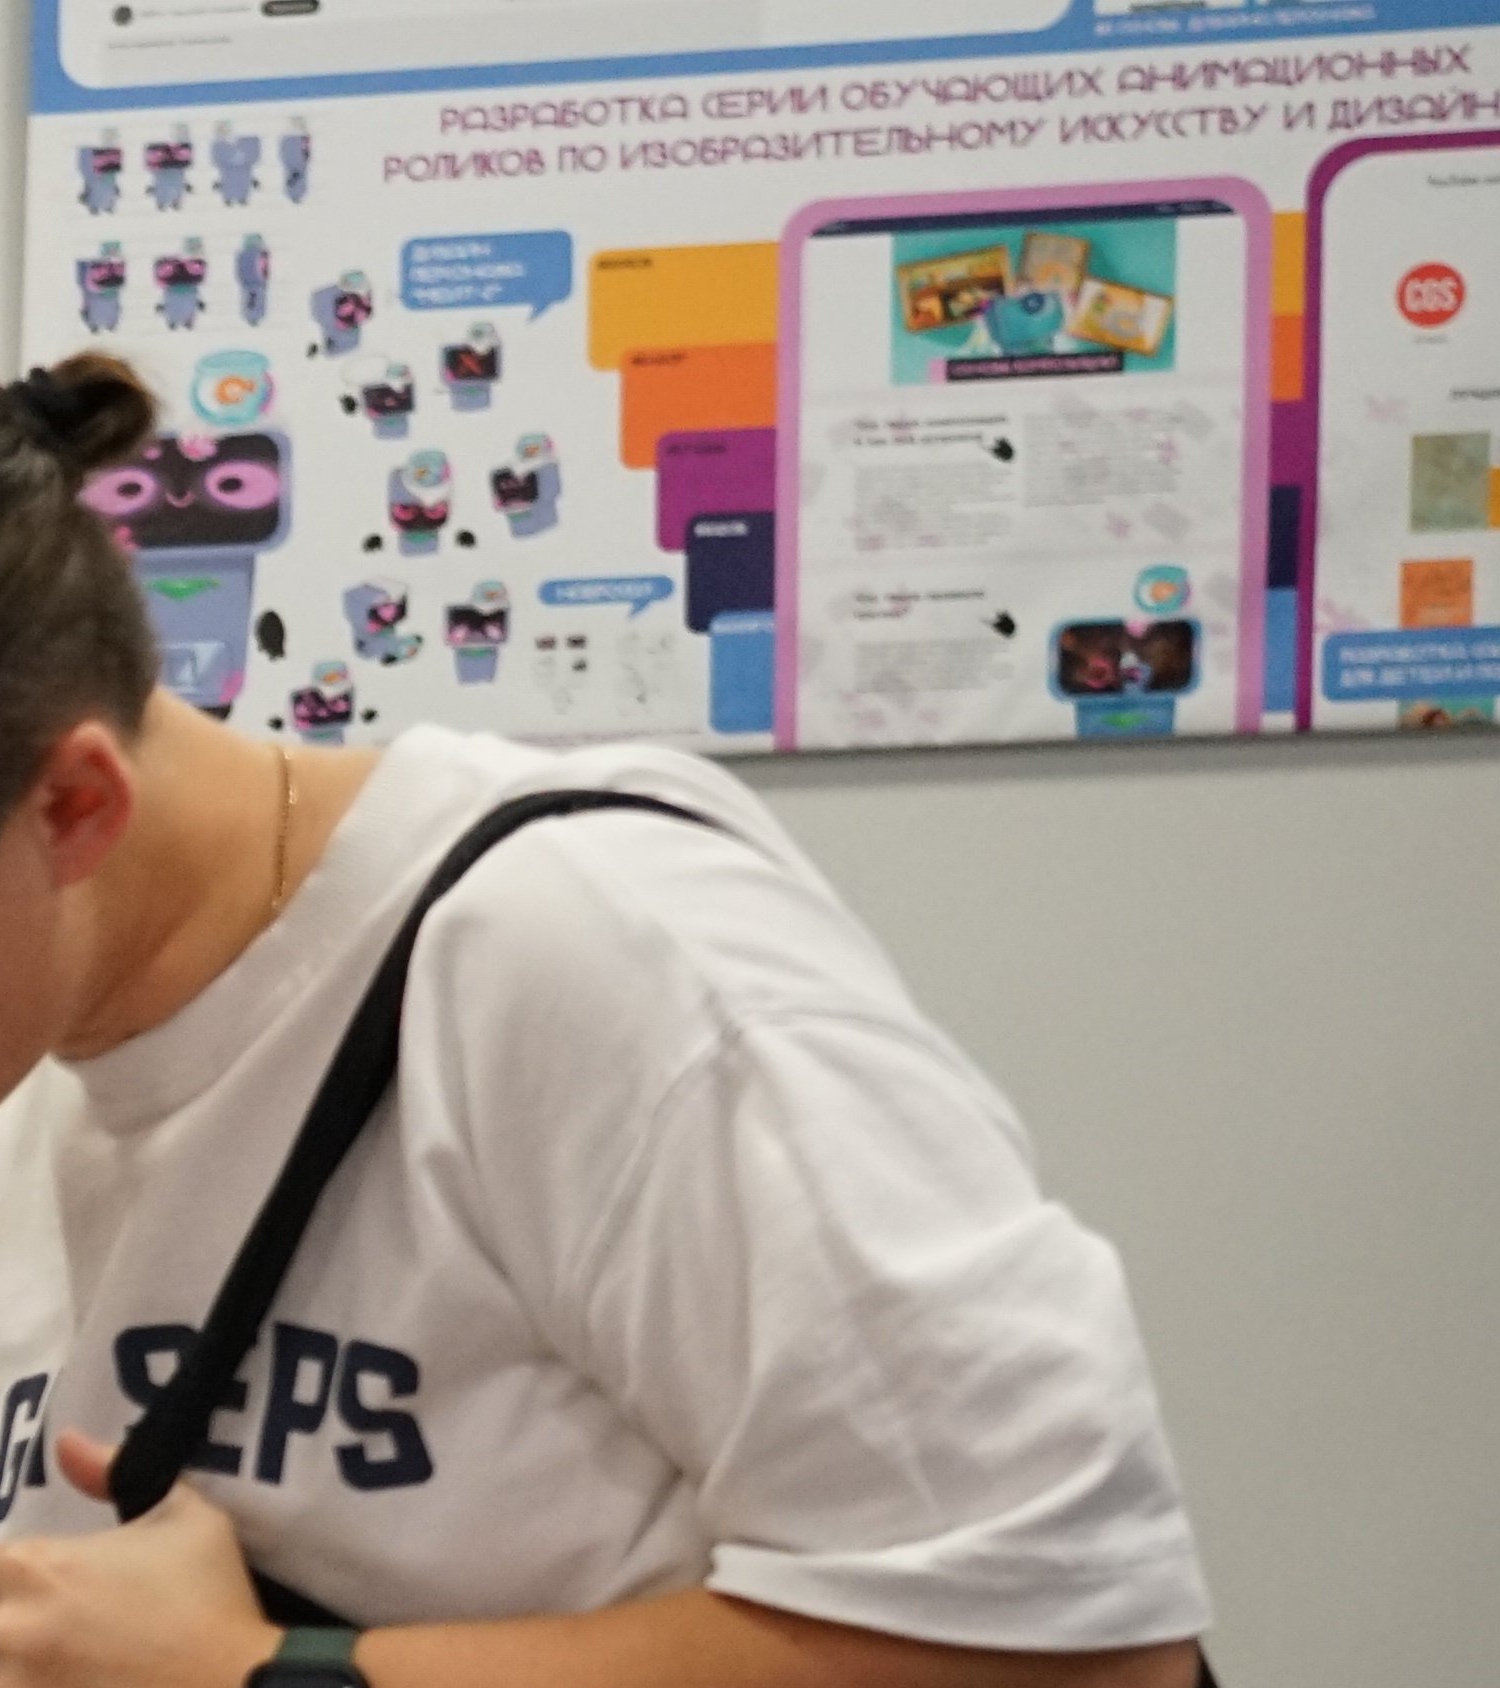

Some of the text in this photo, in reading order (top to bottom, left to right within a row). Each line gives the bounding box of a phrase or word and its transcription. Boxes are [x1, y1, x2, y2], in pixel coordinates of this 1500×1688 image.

[440, 43, 1472, 134] РАЗРАБОТКА СЕРИИ ОБУЧАЮЩИХ АНИМАЦИОННЫХ
[383, 147, 546, 182] РОЛИКОВ
[557, 143, 607, 173] ПО
[619, 116, 1046, 170] ИЗОБРАЗИТЕЛЬНОМУ
[1058, 103, 1268, 143] ИСКУССТВУ
[1283, 102, 1317, 133] И
